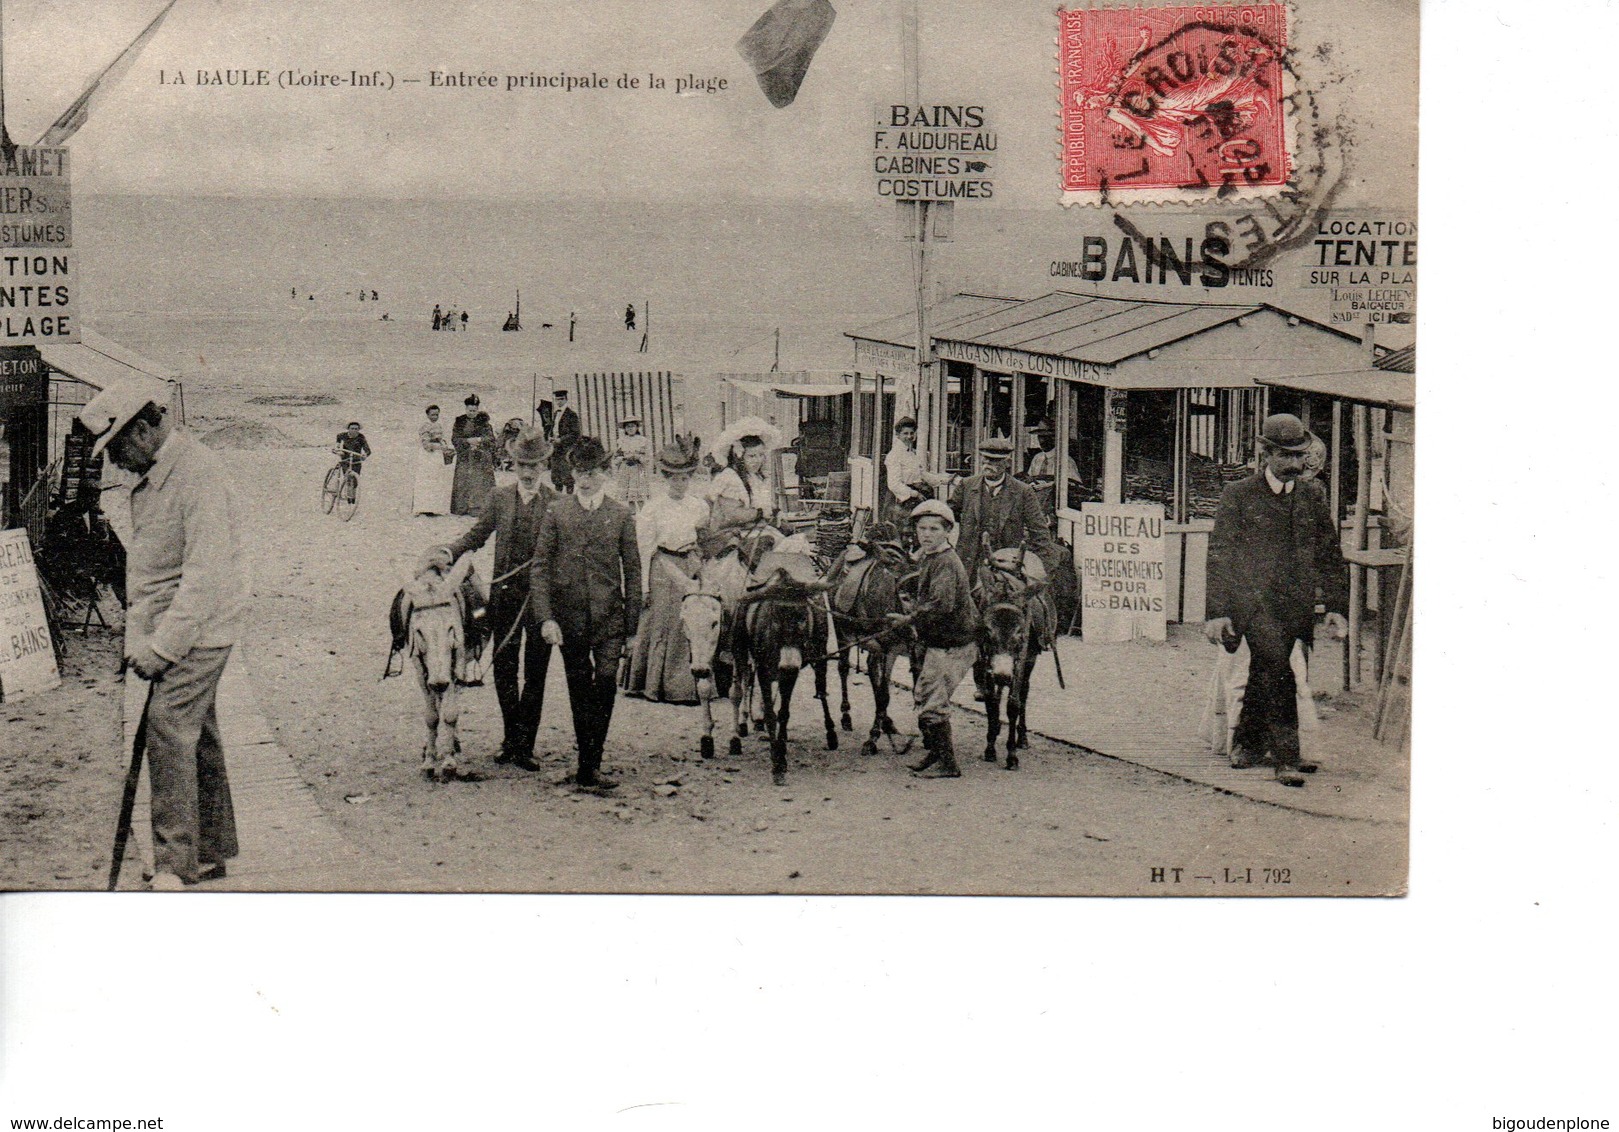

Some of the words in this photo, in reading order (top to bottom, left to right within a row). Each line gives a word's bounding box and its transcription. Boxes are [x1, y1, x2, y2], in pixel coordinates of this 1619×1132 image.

[1066, 13, 1083, 86] FRANÇAISE
[889, 104, 985, 128] BAINS
[874, 131, 889, 149] F.
[896, 132, 998, 151] AUDUREAU
[0, 148, 67, 177] AMET
[874, 156, 961, 175] CABINES
[877, 178, 994, 198] COSTUMES
[1, 224, 66, 243] STUMES
[1050, 260, 1083, 278] CABINES
[1081, 235, 1231, 289] BAINS
[1231, 266, 1274, 288] TENTES
[1314, 239, 1418, 267] TENTE
[4, 256, 69, 276] TION
[1310, 270, 1340, 287] SUR
[1349, 271, 1371, 285] LA
[1380, 271, 1415, 285] PLA
[1351, 301, 1405, 311] BAIGNEUR
[0, 316, 71, 338] LAGE
[1368, 312, 1385, 322] ICI
[0, 359, 38, 377] ETON
[946, 341, 1004, 365] MAGASIN
[1006, 352, 1025, 370] des
[1028, 354, 1101, 382] COSTUMES
[1084, 513, 1162, 539] BUREAU
[1103, 541, 1141, 555] DES
[1084, 557, 1164, 581] RENSEIGNEMENTS
[1100, 579, 1148, 594] POUR
[1108, 594, 1164, 613] BAINS
[10, 625, 49, 661] BAINS
